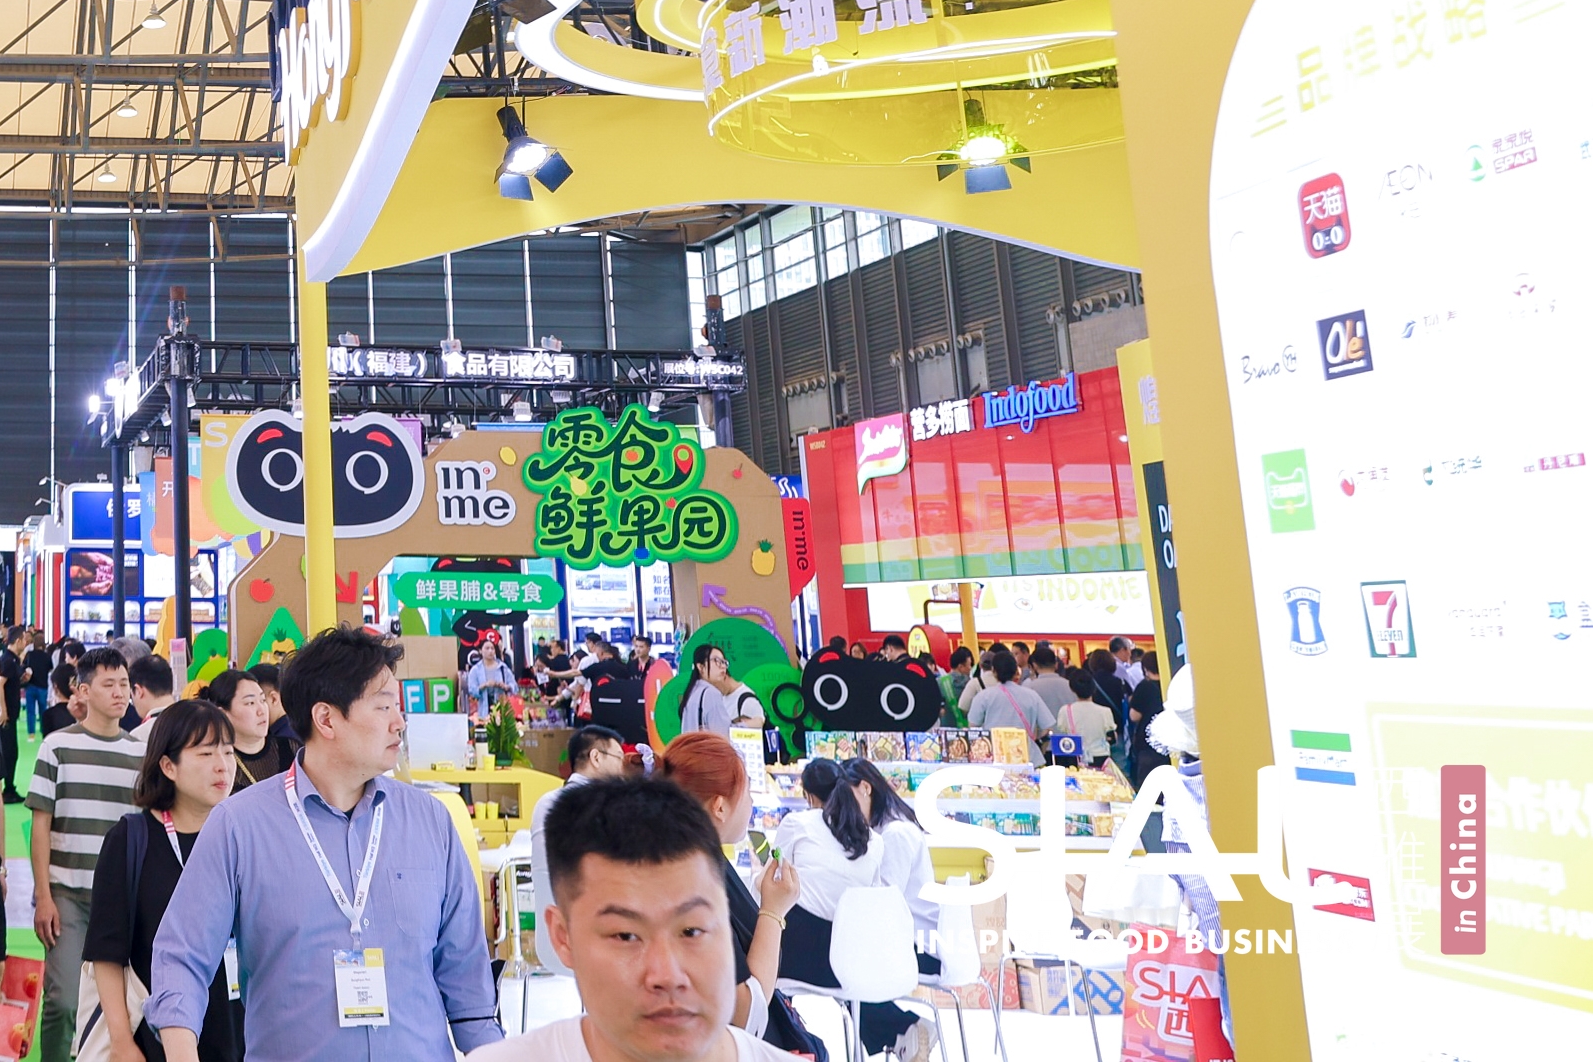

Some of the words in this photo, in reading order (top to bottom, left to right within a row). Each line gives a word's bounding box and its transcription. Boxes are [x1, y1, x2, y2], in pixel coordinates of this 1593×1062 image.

[1494, 149, 1535, 173] SPAR
[1303, 185, 1345, 225] 天猫
[910, 399, 971, 442] 营多捞面
[982, 372, 1078, 433] Indofood
[529, 410, 692, 490] 零食
[442, 495, 511, 520] me
[541, 488, 725, 560] 鲜果园
[416, 578, 543, 604] 鲜果脯&零食
[433, 682, 450, 708] P
[1139, 966, 1213, 1005] SIA
